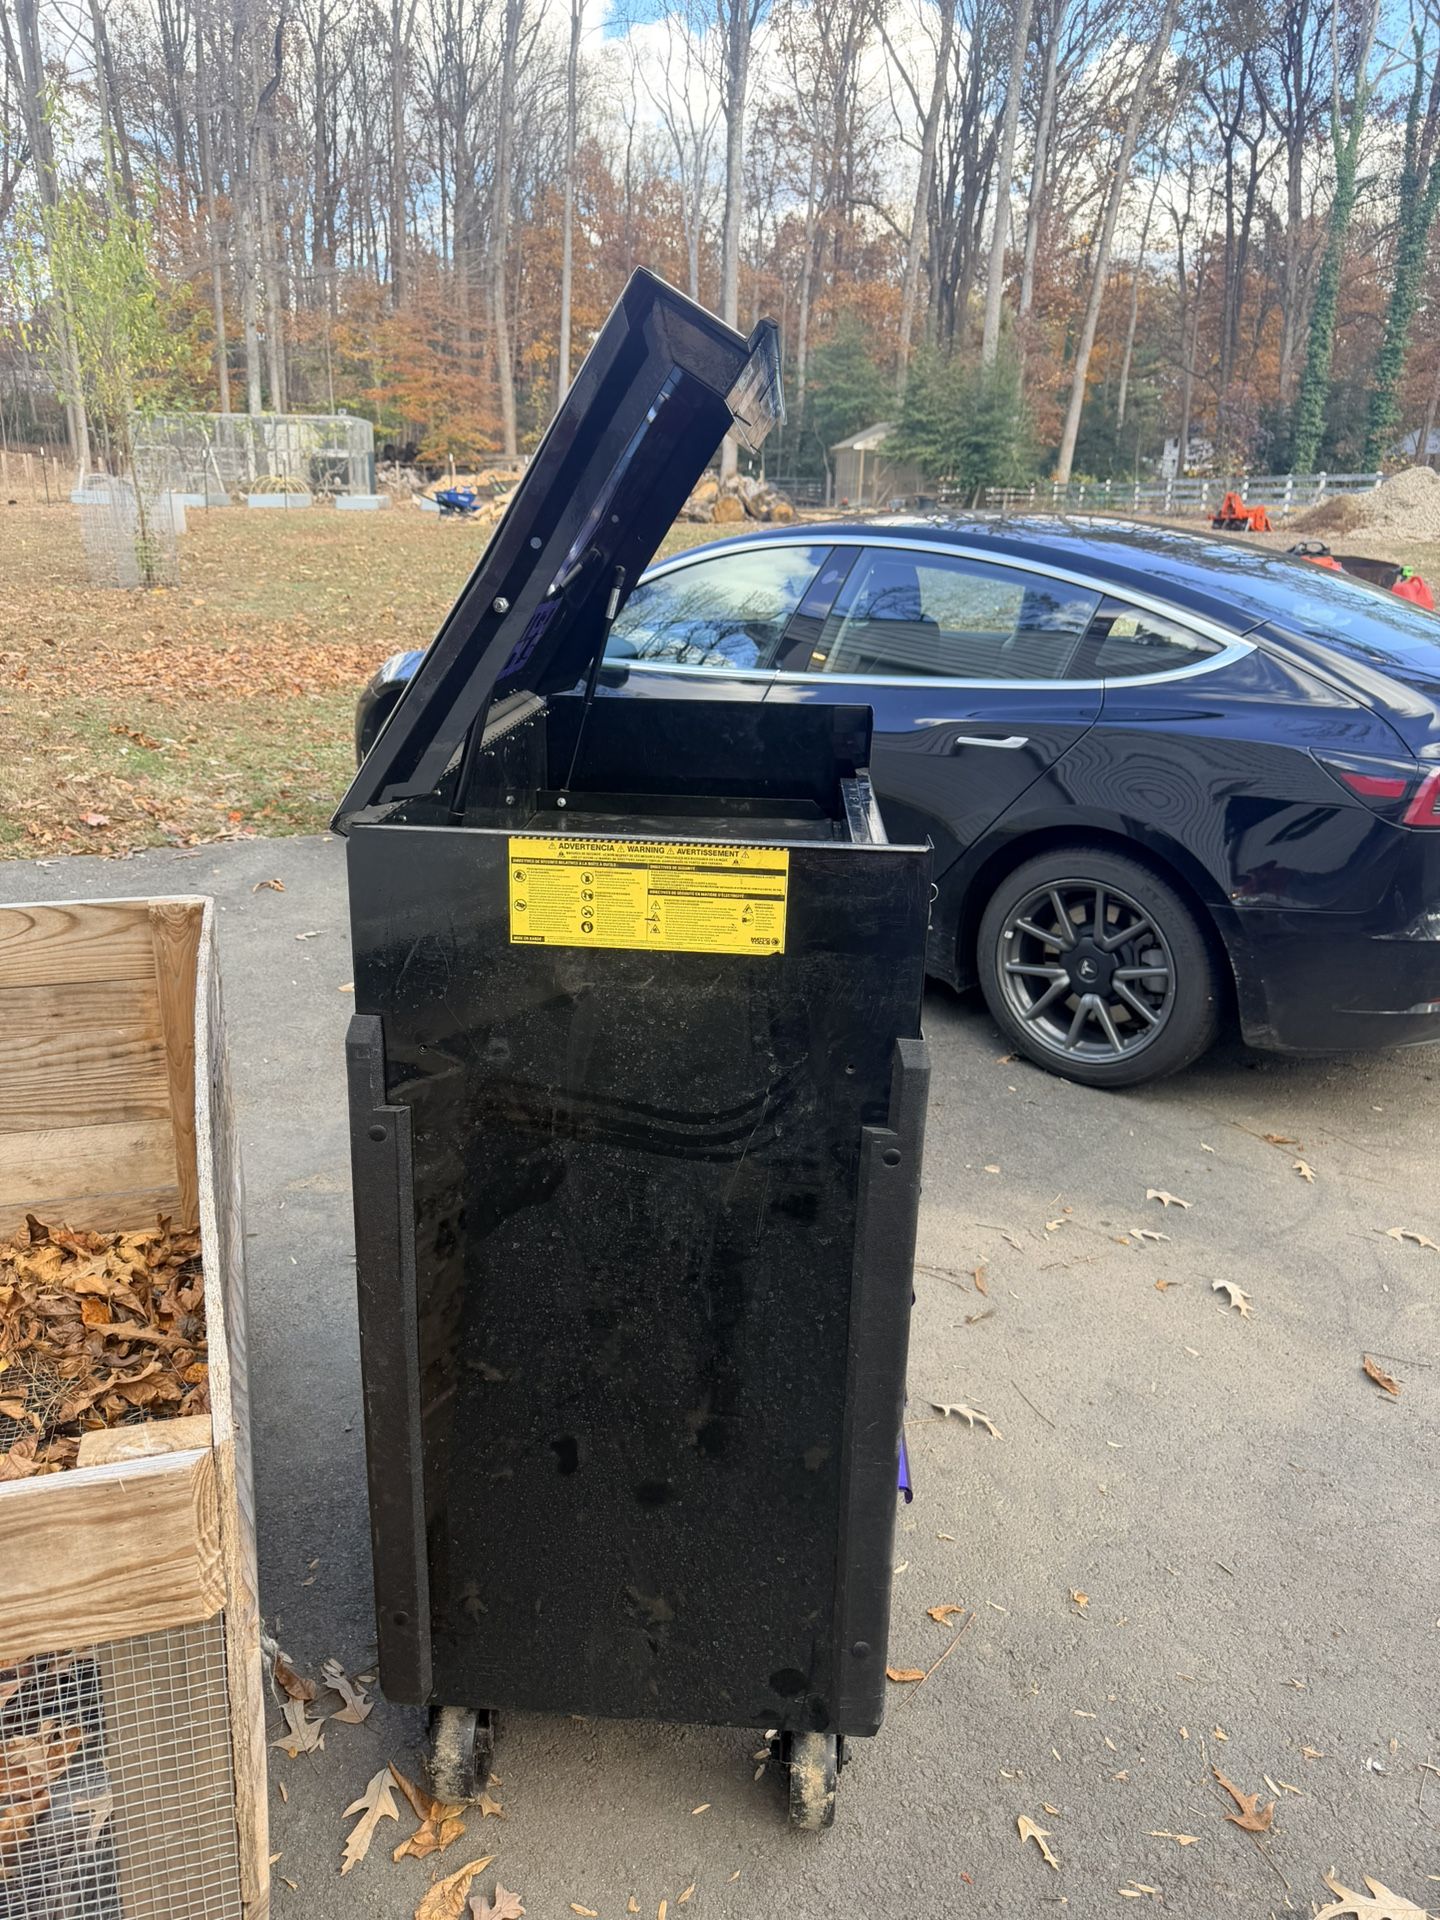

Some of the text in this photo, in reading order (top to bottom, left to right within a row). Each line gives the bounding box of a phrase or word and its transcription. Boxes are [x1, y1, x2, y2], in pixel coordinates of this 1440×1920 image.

[558, 842, 615, 852] ADVERTENCIA
[627, 845, 665, 854] WARNING
[676, 848, 740, 857] AVERTISSEMENT
